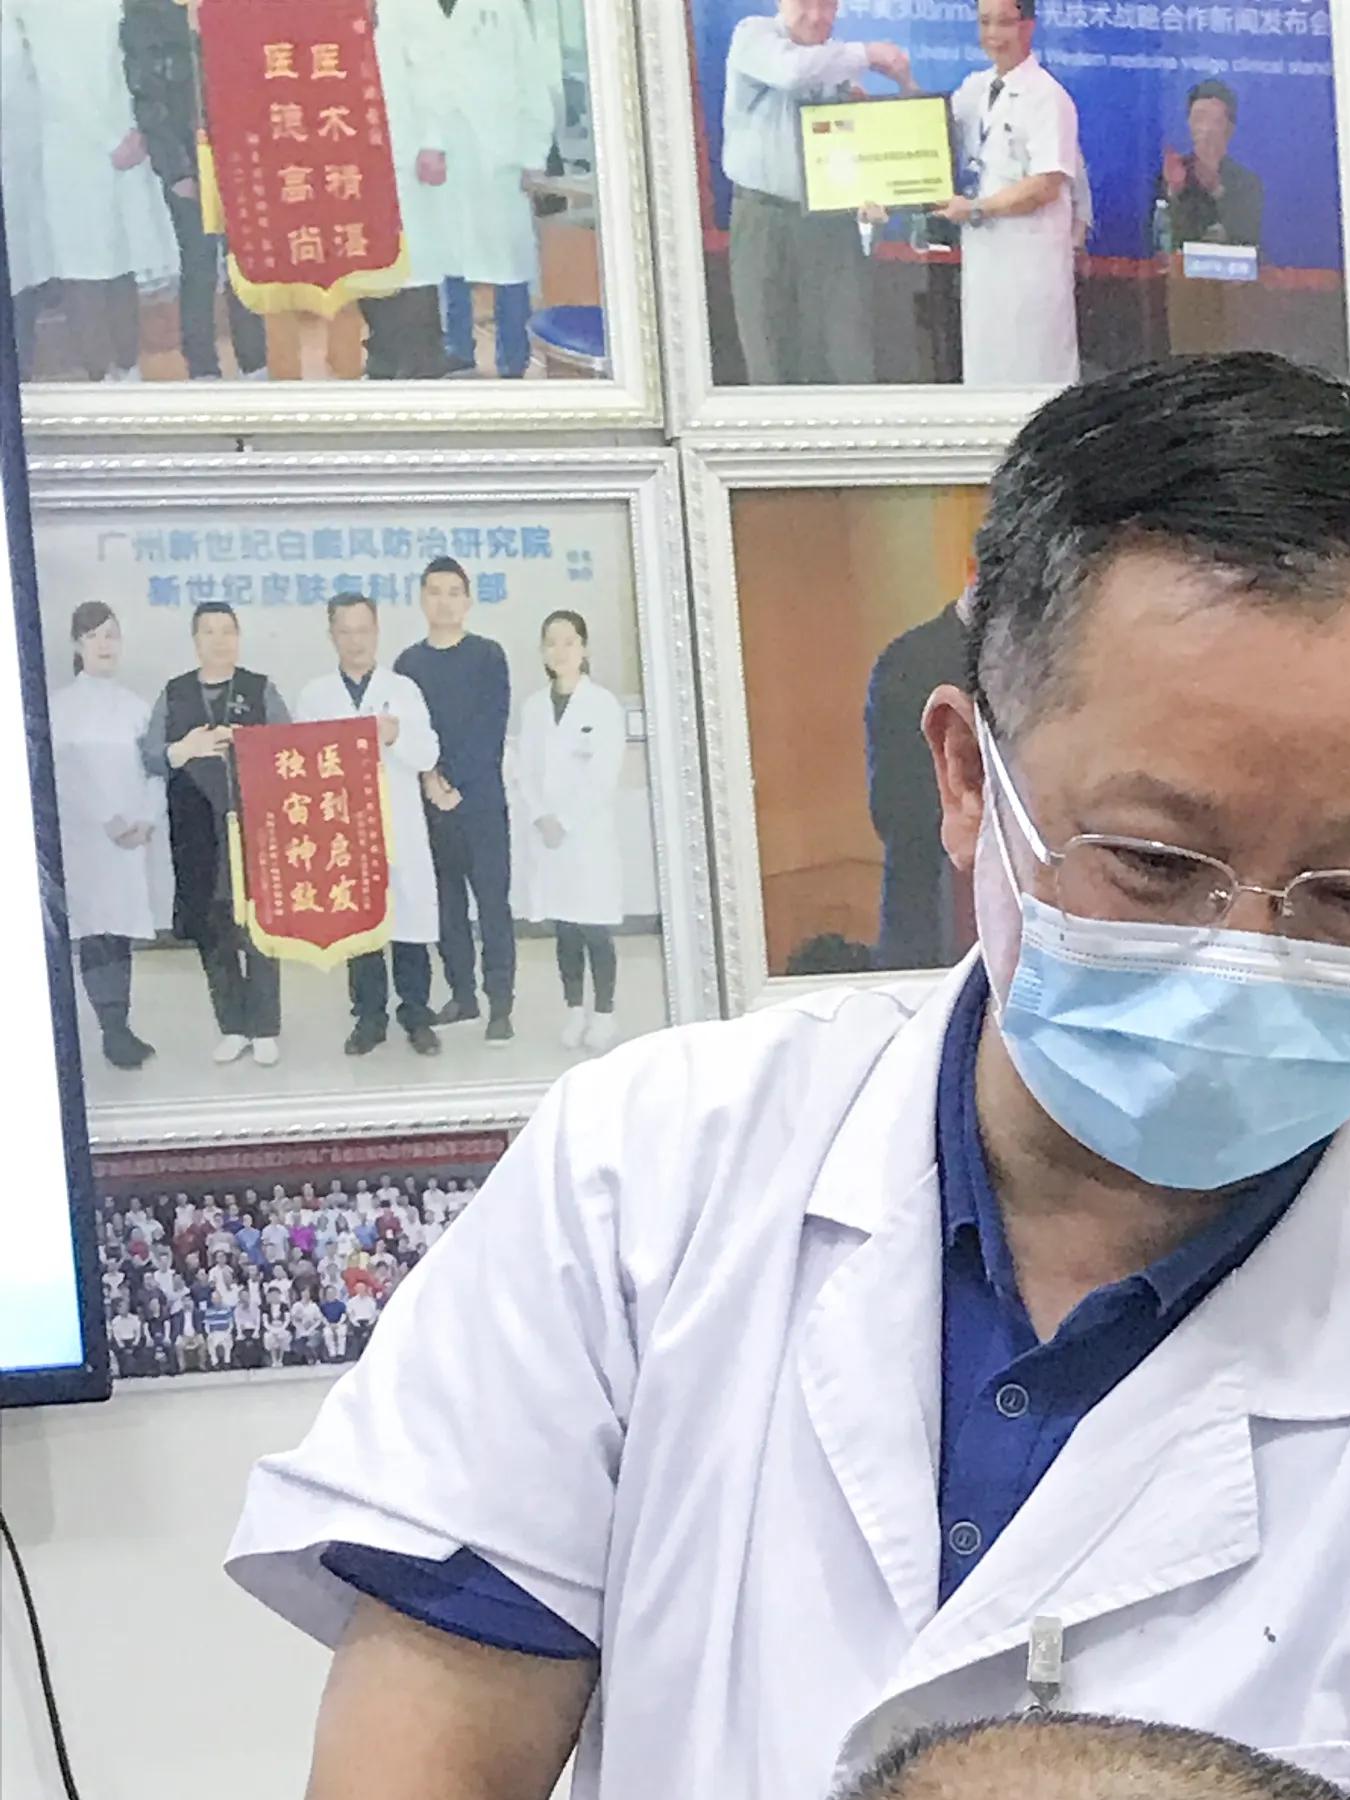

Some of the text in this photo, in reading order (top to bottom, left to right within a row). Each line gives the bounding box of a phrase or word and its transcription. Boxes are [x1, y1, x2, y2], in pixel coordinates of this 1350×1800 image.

[1035, 1, 1329, 35] 光技术战略合作新闻发布会
[97, 525, 553, 562] 广州新世纪白癜风防治研究院
